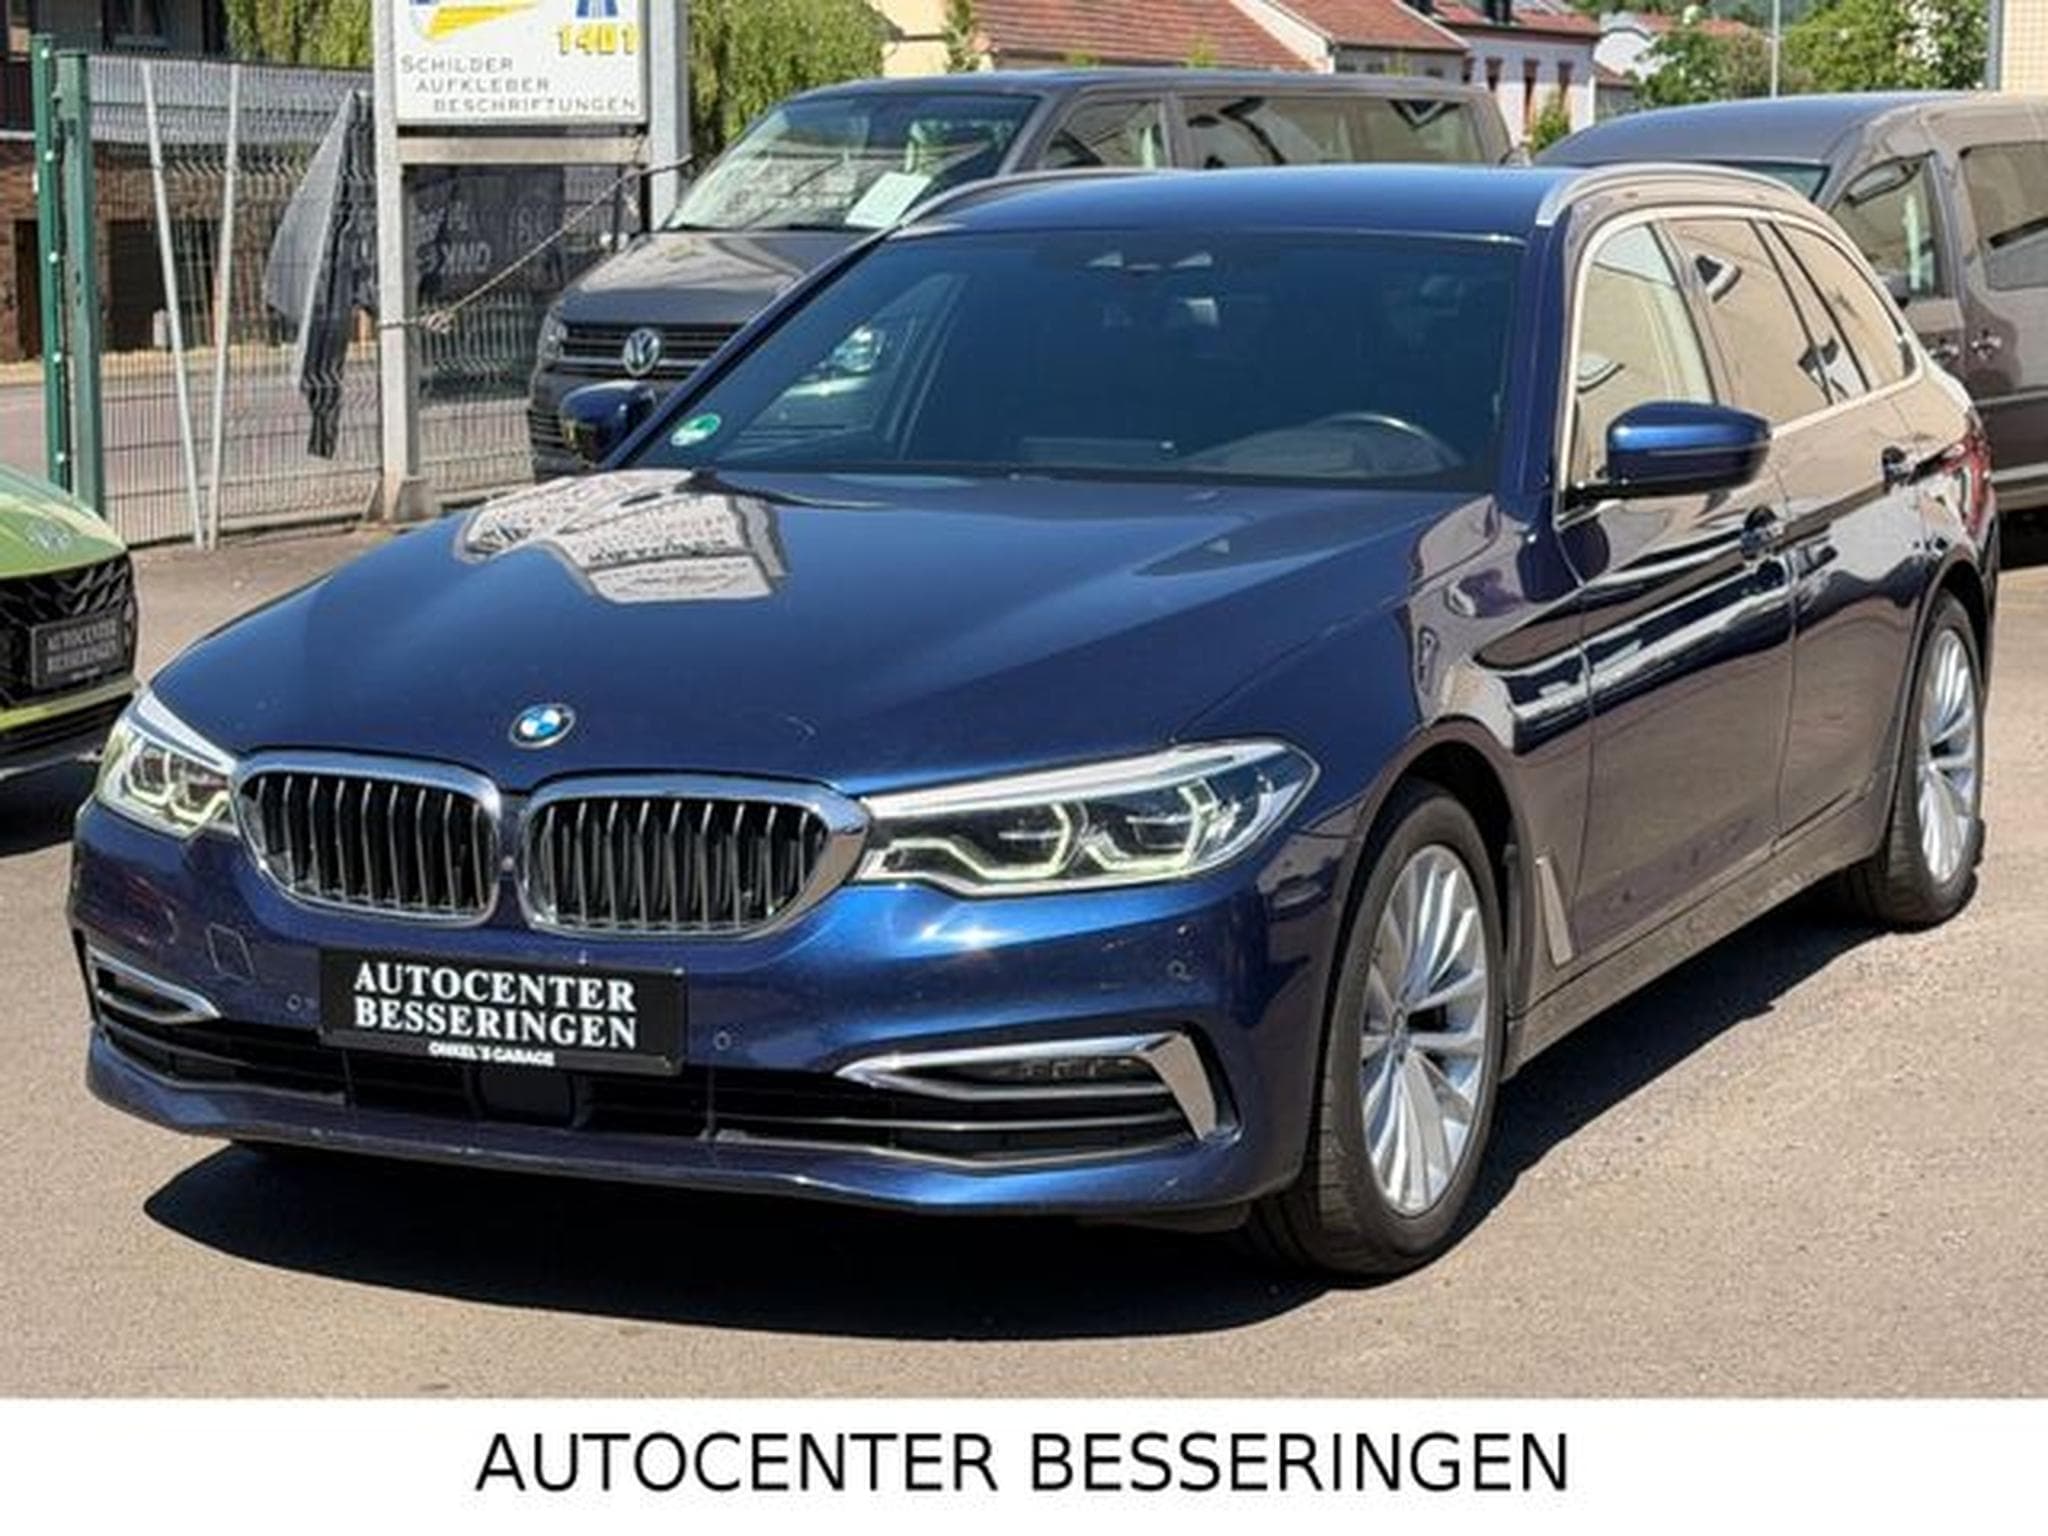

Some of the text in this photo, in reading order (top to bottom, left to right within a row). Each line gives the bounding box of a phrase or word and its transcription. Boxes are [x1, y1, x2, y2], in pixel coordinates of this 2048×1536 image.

[400, 54, 514, 75] SCHILDER
[415, 77, 550, 94] AUFKLEBER
[433, 98, 637, 113] BESCHRIFTUNGEN
[353, 961, 637, 1013] AUTOCENTER
[353, 995, 637, 1049] BESSERINGEN
